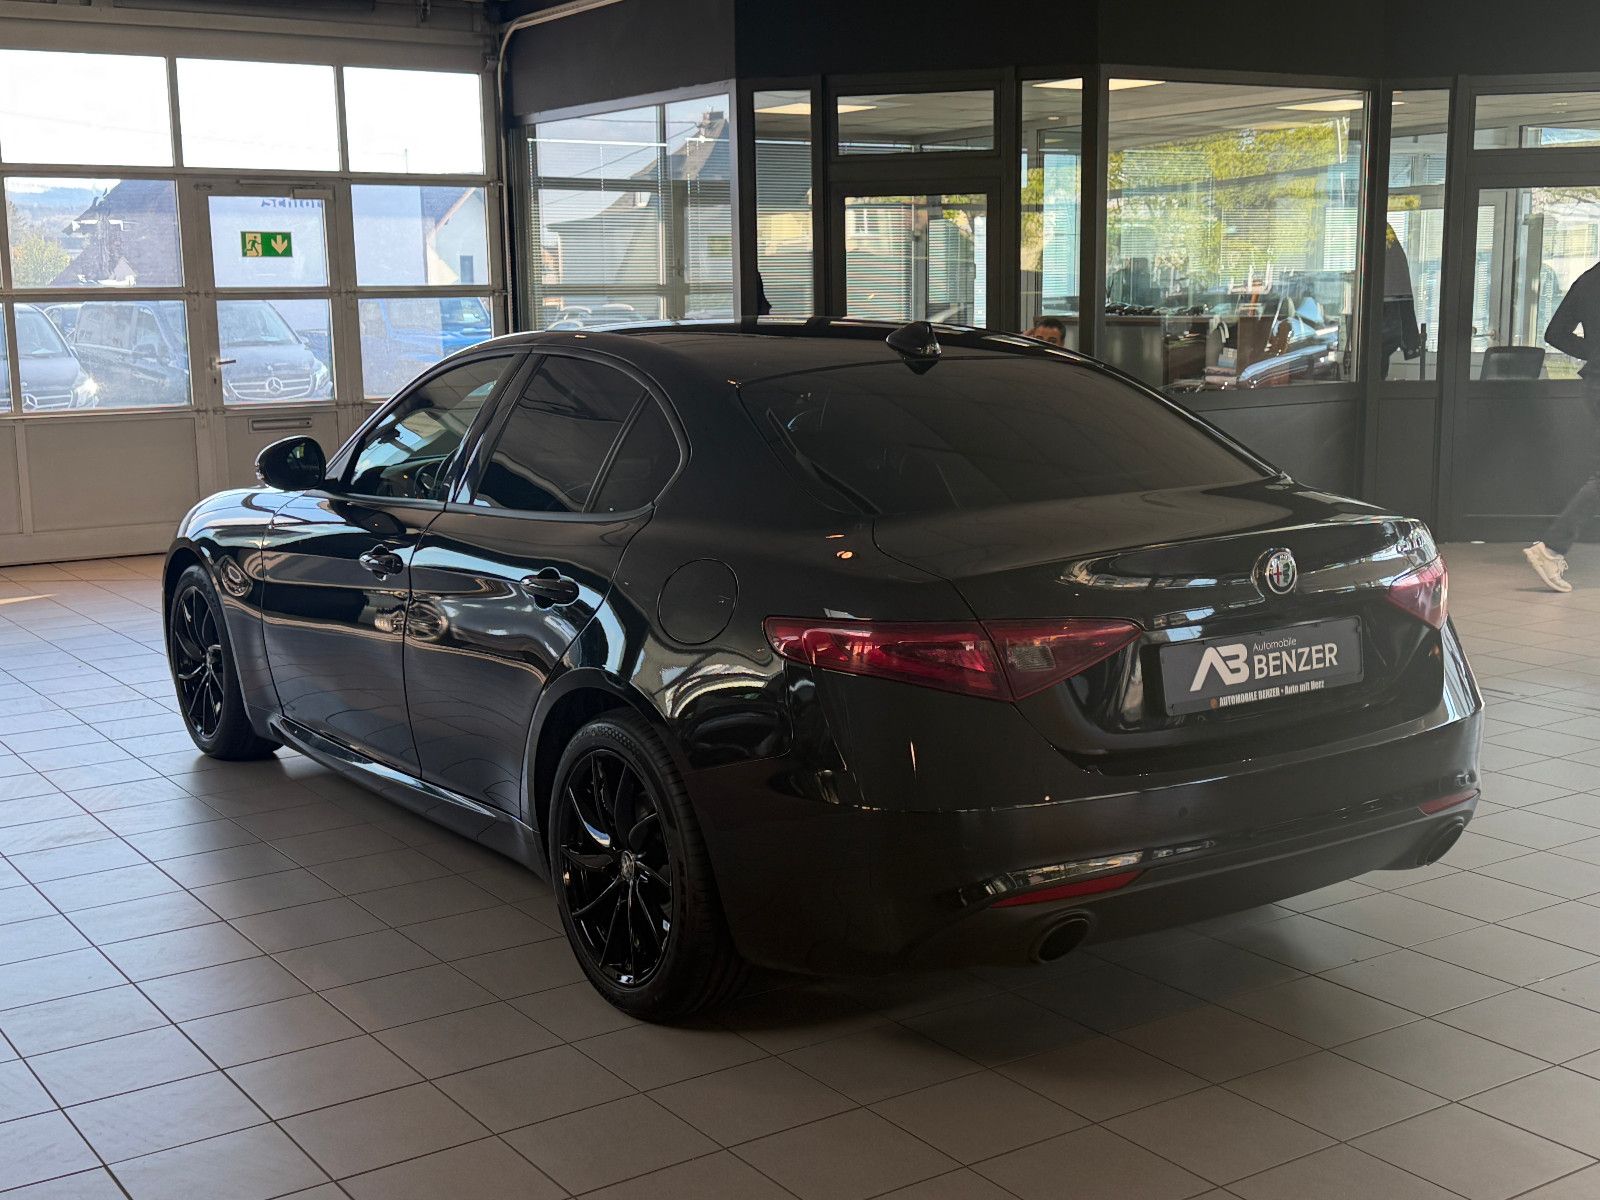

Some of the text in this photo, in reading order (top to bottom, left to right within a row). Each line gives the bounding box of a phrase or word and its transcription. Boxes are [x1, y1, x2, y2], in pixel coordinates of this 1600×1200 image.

[1253, 637, 1297, 652] Automobile
[1253, 643, 1338, 680] BENZER
[1219, 691, 1258, 707] AUTOMOBILE
[1258, 687, 1280, 700] BENZER
[1284, 684, 1299, 695] Auto
